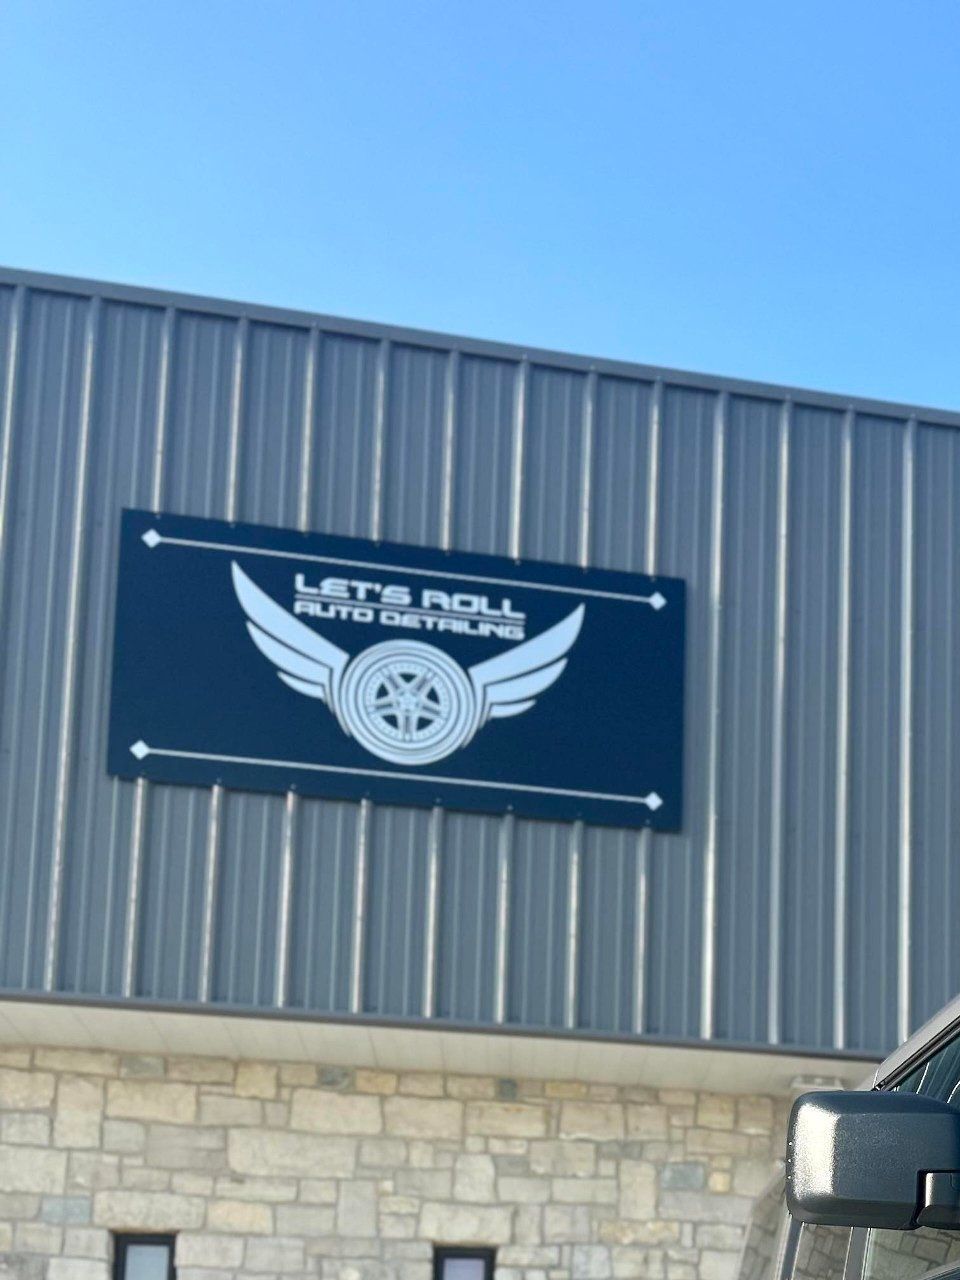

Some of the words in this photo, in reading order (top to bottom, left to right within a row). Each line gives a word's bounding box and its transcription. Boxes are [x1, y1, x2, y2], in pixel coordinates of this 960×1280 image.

[295, 573, 413, 606] LET'S
[421, 588, 526, 620] ROLL
[293, 601, 374, 623] AUTO
[379, 610, 525, 641] DETAILING
